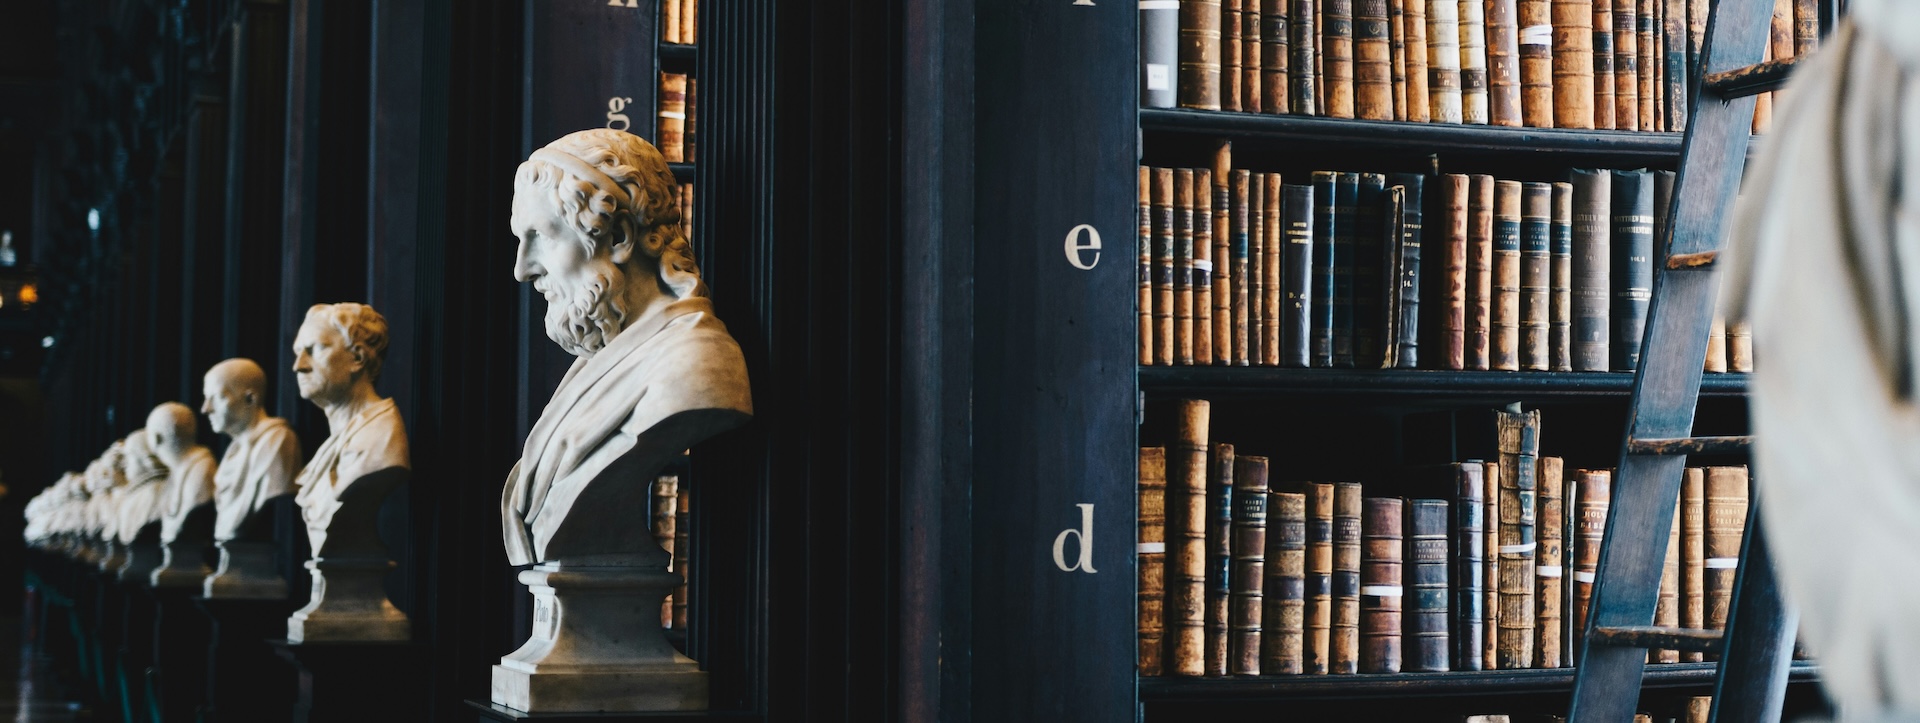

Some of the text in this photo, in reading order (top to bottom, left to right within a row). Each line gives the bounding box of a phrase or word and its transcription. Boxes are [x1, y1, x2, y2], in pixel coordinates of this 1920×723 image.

[607, 97, 633, 132] g
[1064, 223, 1102, 270] e
[1052, 503, 1098, 573] d
[535, 598, 549, 622] Plato
